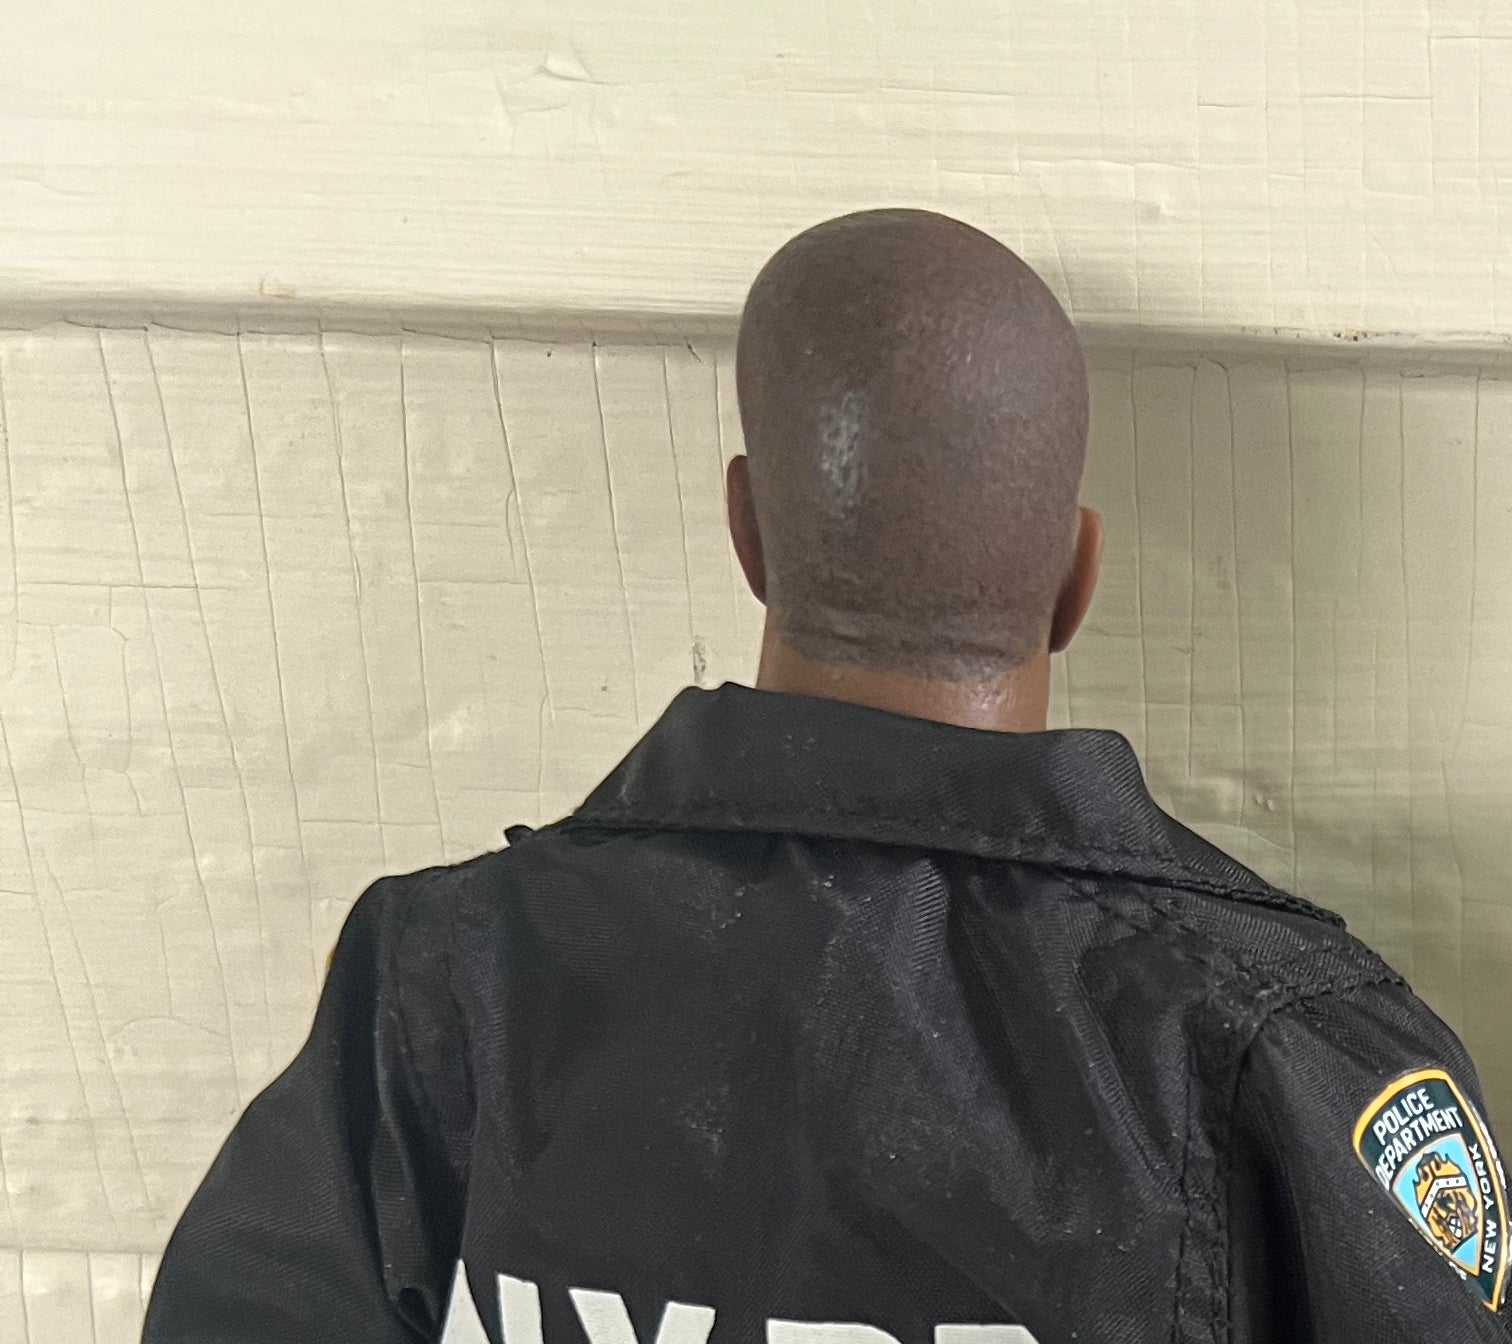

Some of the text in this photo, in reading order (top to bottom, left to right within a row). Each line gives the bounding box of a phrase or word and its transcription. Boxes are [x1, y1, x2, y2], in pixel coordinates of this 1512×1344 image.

[1372, 1088, 1435, 1146] POLICE
[1374, 1106, 1464, 1188] DEPARTMENT
[1467, 1143, 1498, 1274] NEW YORK
